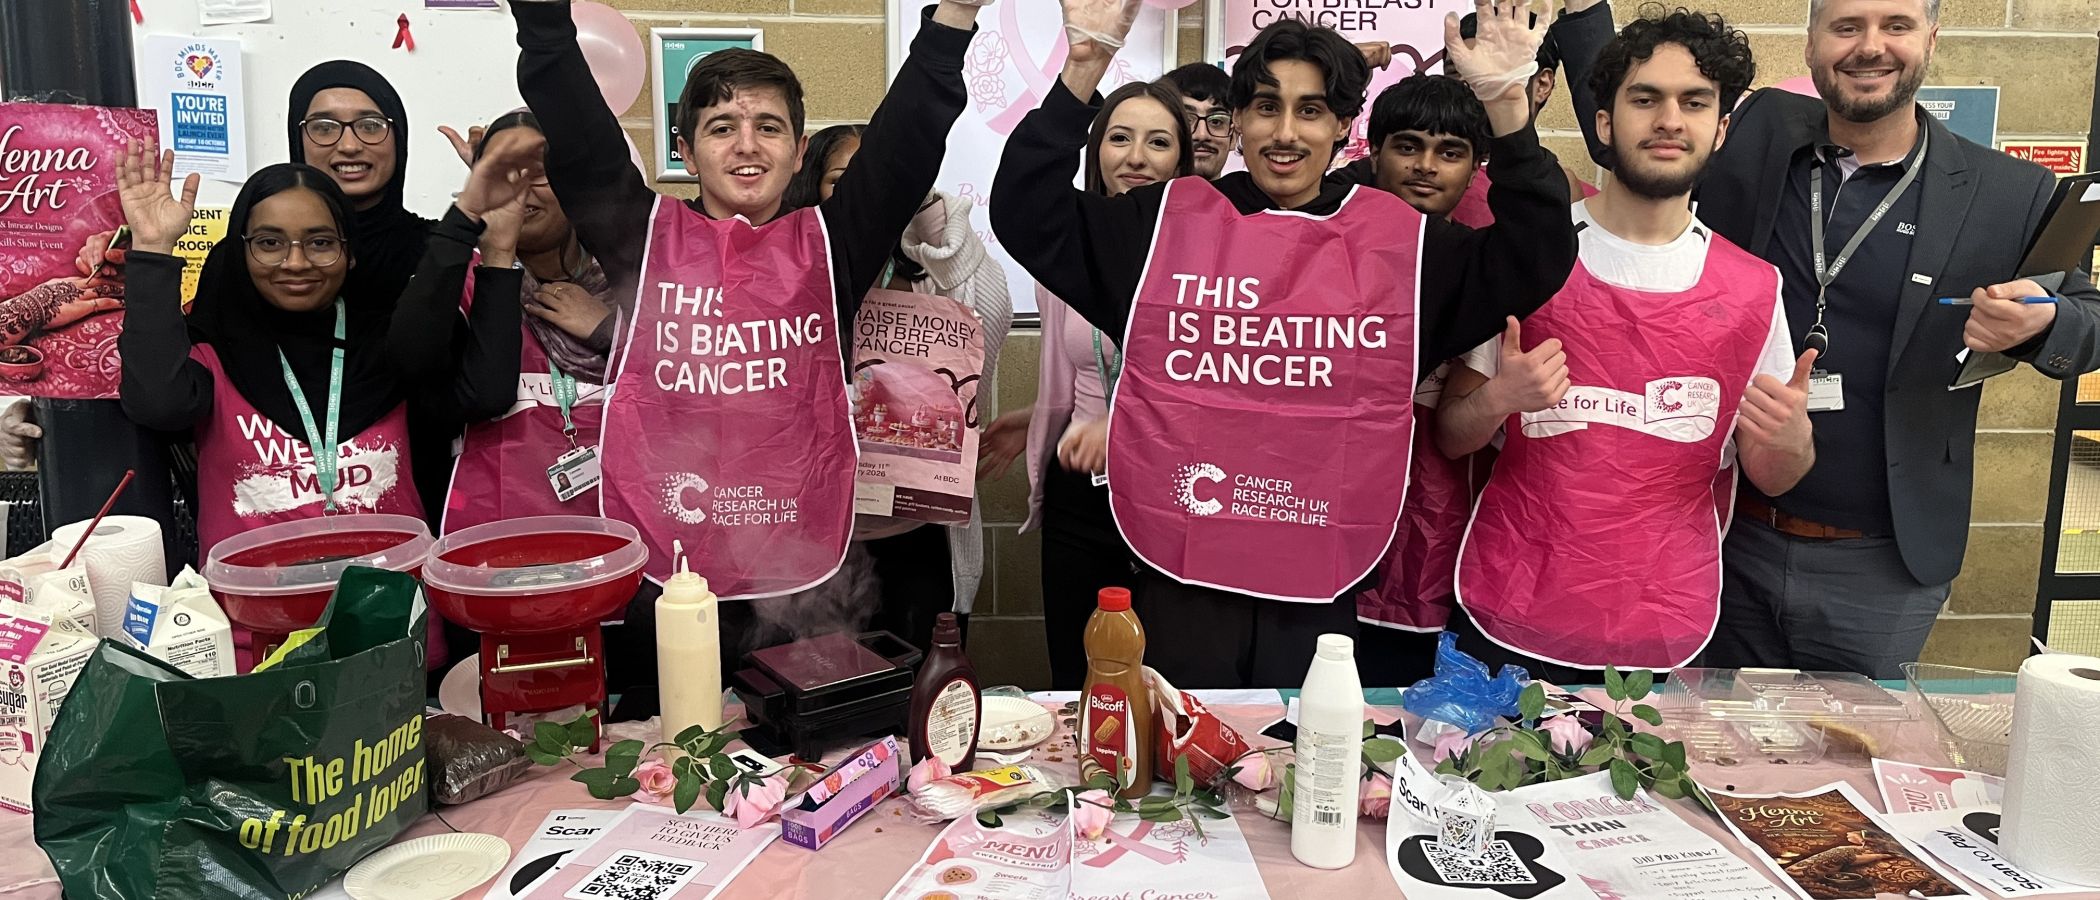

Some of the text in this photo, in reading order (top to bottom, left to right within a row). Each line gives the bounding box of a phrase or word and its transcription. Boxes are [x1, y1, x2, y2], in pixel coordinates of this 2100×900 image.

[177, 43, 206, 59] MINDS
[174, 60, 185, 79] BDC
[176, 95, 224, 112] YOU'RE
[1937, 102, 1954, 110] YOUR
[177, 110, 225, 126] INVITED
[2033, 149, 2069, 158] Fire fighting
[2033, 157, 2064, 165] equipment
[0, 173, 72, 215] Art
[8, 220, 33, 230] Intricate
[35, 222, 63, 232] Designs
[17, 239, 37, 248] Show
[40, 240, 63, 250] Event
[1172, 274, 1260, 310] THIS
[656, 313, 823, 356] IS BEATING
[912, 314, 976, 339] MONEY
[1168, 311, 1387, 348] IS BEATING
[860, 322, 969, 350] OR BREAST
[858, 337, 930, 358] ANCER
[655, 357, 788, 395] CANCER
[1165, 350, 1333, 387] CANCER
[1688, 382, 1714, 391] CANCER
[1688, 391, 1718, 402] RESEARCH
[1688, 400, 1697, 408] UK
[1574, 395, 1599, 410] for
[1605, 397, 1637, 417] Life
[867, 469, 886, 478] 2026
[944, 476, 959, 484] BDC
[1235, 474, 1293, 493] CANCER
[714, 486, 763, 499] CANCER
[1233, 488, 1330, 513] RESEARCH UK
[712, 497, 797, 513] RESEARCH UK
[712, 510, 797, 526] RACE FOR LIFE
[1231, 503, 1328, 527] RACE FOR LIFE
[167, 636, 211, 651] Nutrition Facts
[204, 651, 217, 659] 110
[1091, 696, 1124, 712] Biscoff
[1096, 746, 1118, 756] topping
[283, 714, 422, 805] The home
[1399, 776, 1431, 817] Scan
[846, 802, 863, 818] BAGS
[1738, 805, 1824, 821] Henna
[239, 810, 286, 857] of
[283, 793, 362, 857] food
[666, 820, 740, 836] SCAN HERE
[1550, 819, 1627, 837] THAN
[1768, 814, 1822, 828] Art
[651, 833, 723, 851] FEEDBACK
[660, 826, 733, 843] TO GIVE US
[787, 831, 809, 844] BAGS
[1575, 833, 1652, 851] CANCER
[975, 851, 1008, 862] SWEETS
[983, 838, 1060, 860] MENU
[1632, 848, 1719, 865] DID YOU KNOW?
[1936, 829, 2043, 891] Scan to Pay
[623, 876, 646, 886] ME
[993, 871, 1028, 881] Sweets
[1140, 888, 1217, 900] Cancer
